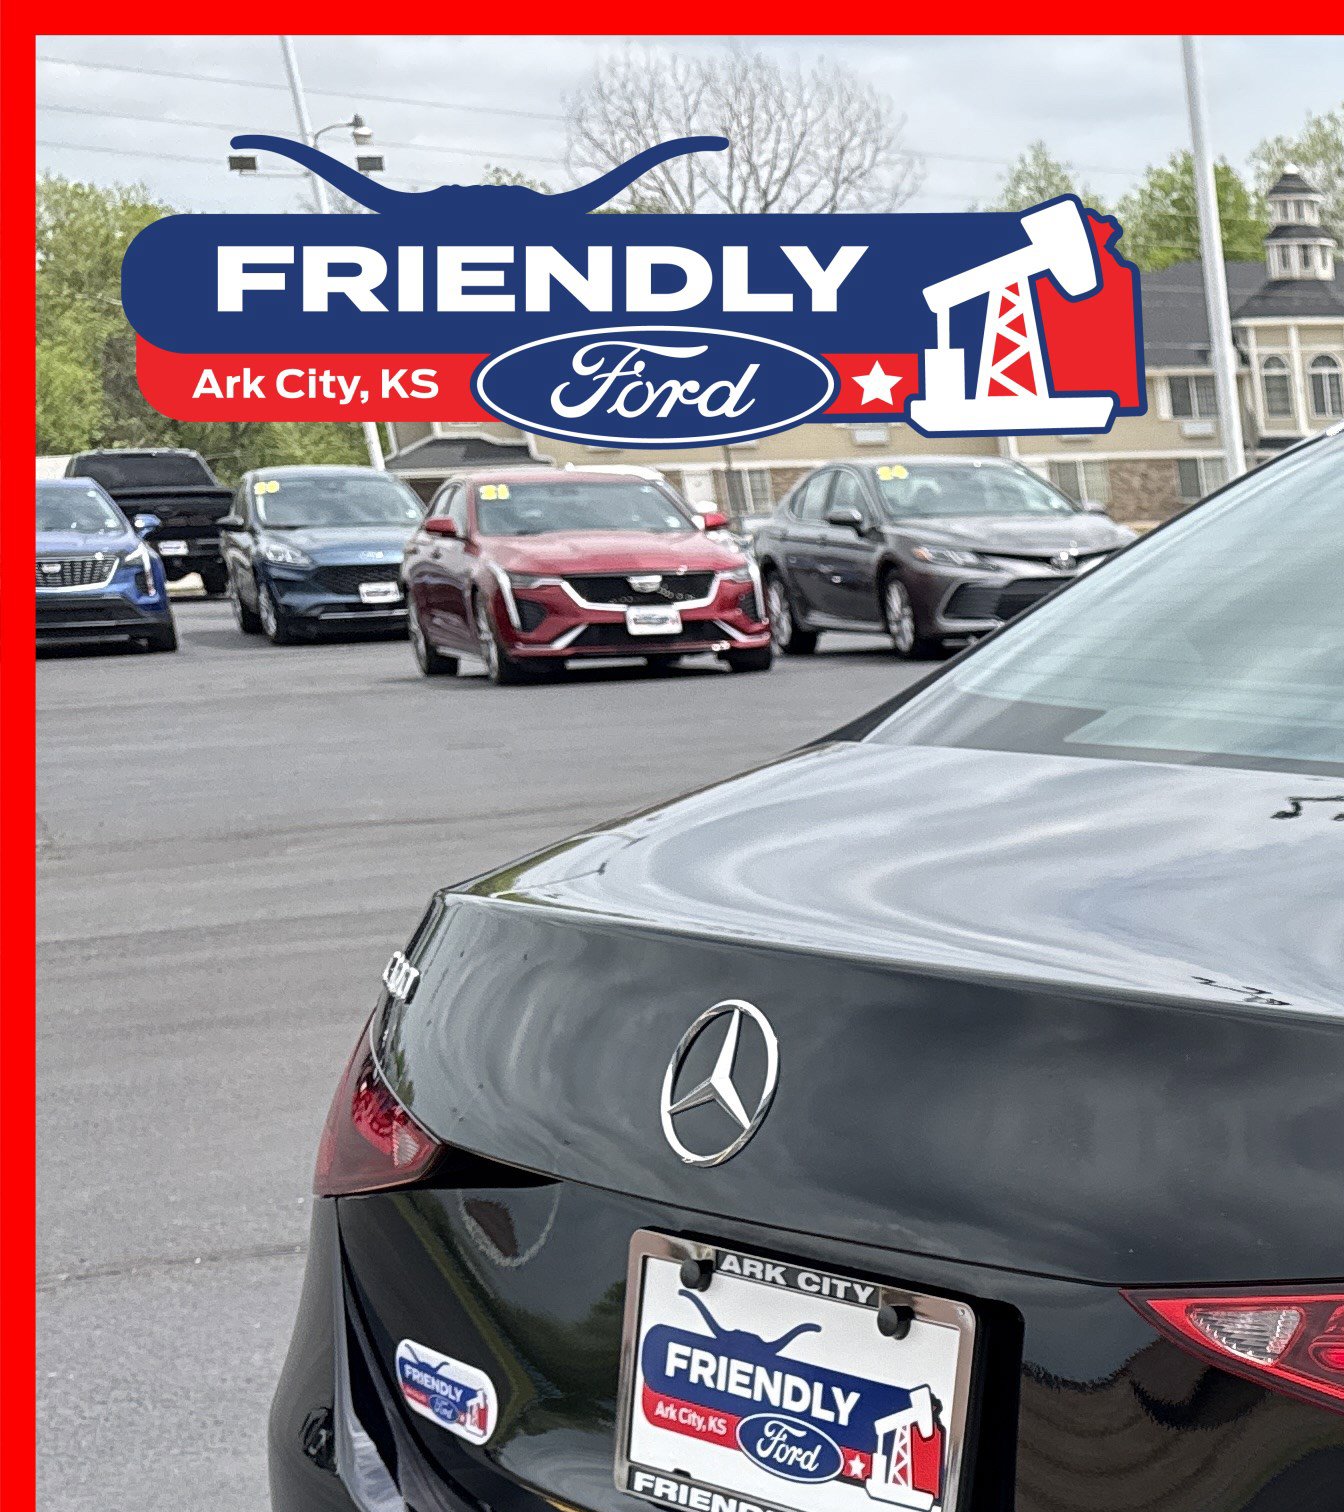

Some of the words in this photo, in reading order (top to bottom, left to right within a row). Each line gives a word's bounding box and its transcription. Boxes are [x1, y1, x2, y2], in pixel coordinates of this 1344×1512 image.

[720, 1253, 789, 1286] ARK
[797, 1271, 875, 1304] CITY
[403, 1363, 464, 1403] FRIENDLY
[665, 1341, 860, 1427] FRIENDLY
[654, 1401, 678, 1420] Ark
[706, 1417, 727, 1436] KS
[756, 1419, 822, 1474] Ford
